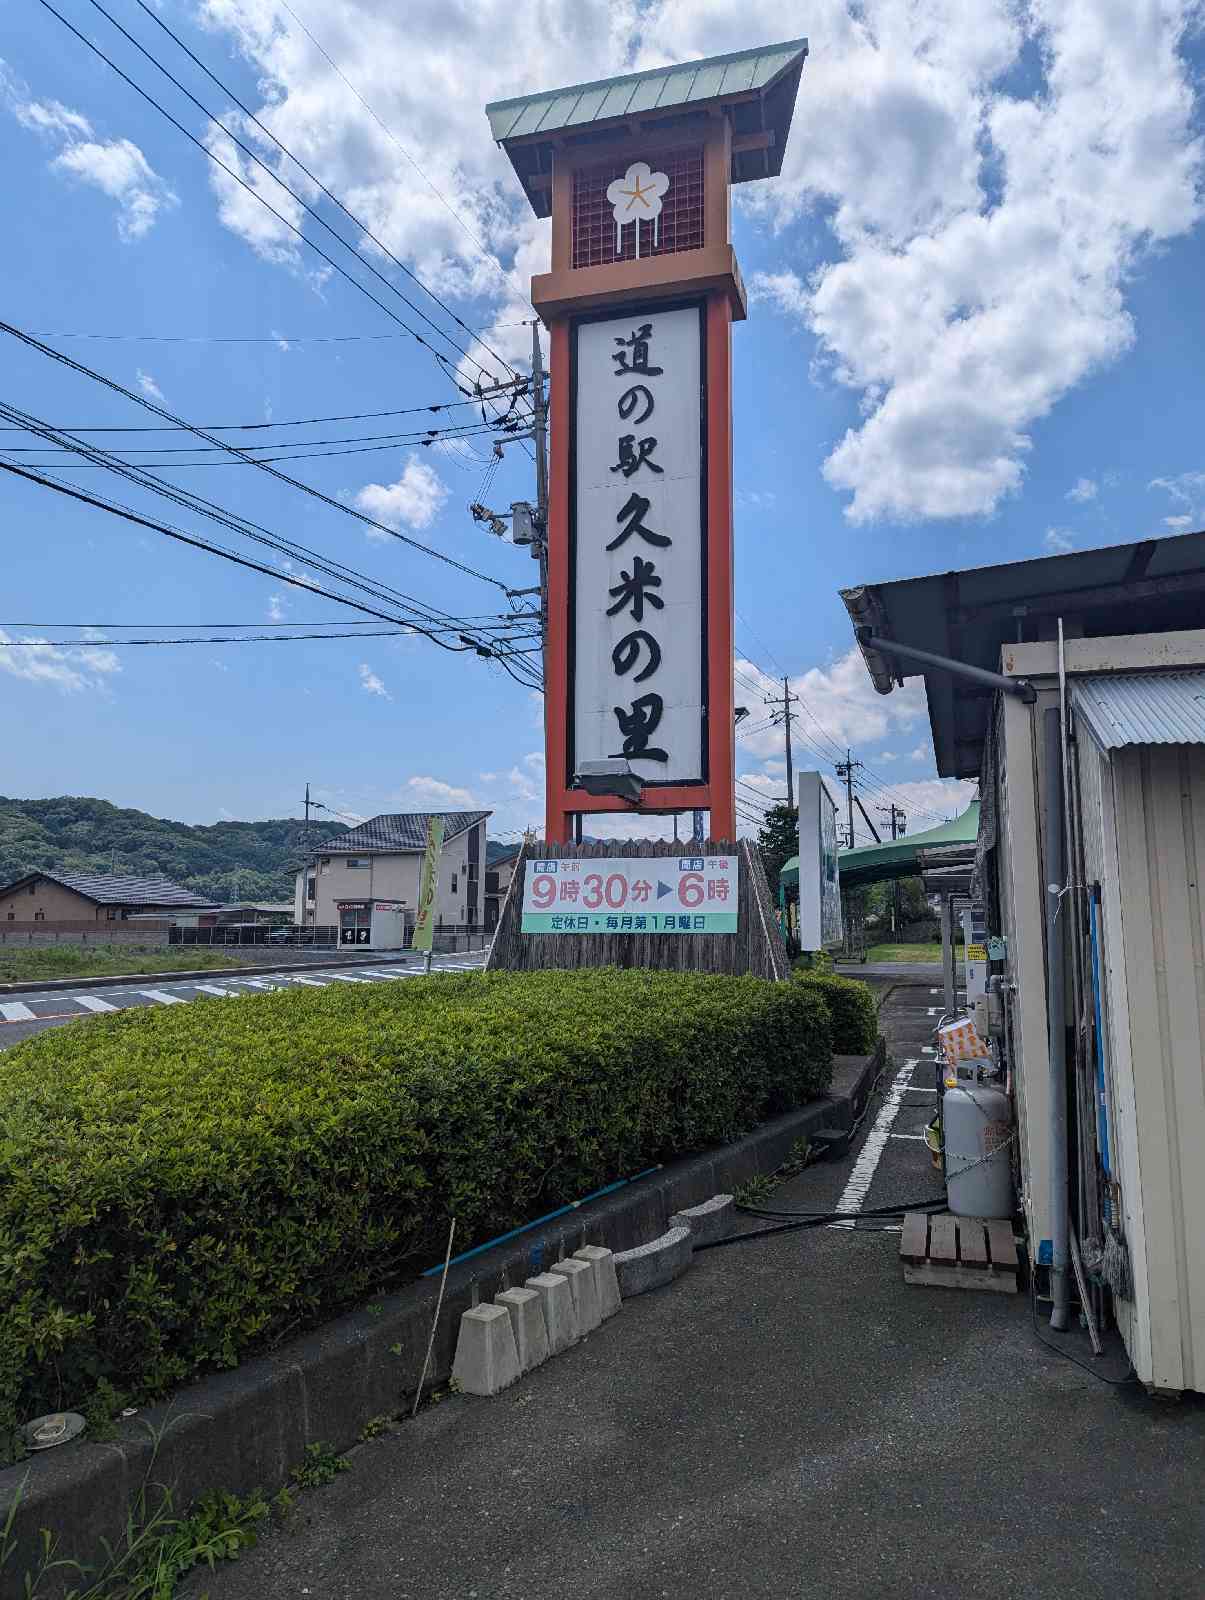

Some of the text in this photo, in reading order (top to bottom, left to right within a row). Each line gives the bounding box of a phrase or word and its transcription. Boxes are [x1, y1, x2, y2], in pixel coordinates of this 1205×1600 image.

[606, 323, 672, 762] 道の駅久米の里
[531, 872, 730, 909] 9時30分 6時
